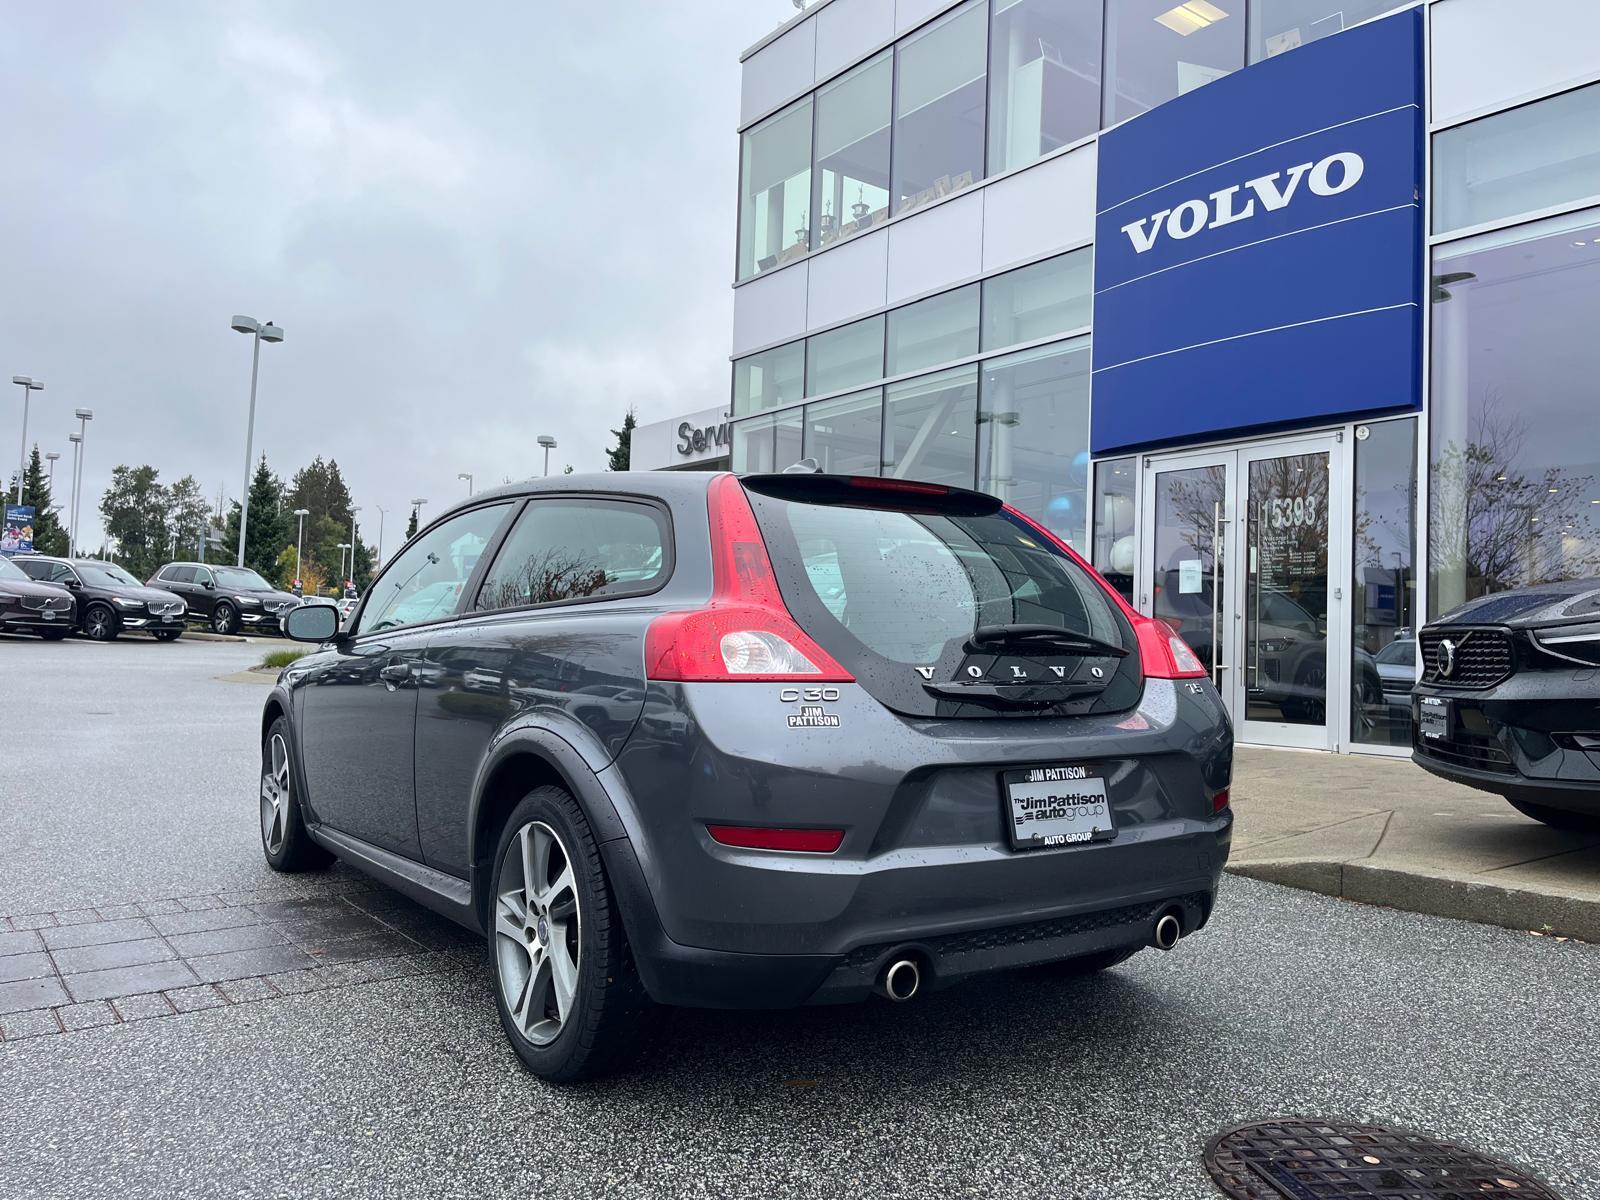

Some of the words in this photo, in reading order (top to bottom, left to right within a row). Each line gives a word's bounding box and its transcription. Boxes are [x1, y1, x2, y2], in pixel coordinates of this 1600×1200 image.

[1121, 152, 1364, 254] VOLVO
[676, 412, 730, 455] Servi
[1262, 496, 1315, 528] 15393
[915, 666, 1104, 680] VOLVO
[1185, 683, 1203, 694] T5
[803, 707, 823, 717] JIM
[789, 716, 839, 726] PATTISON
[1030, 769, 1044, 782] JIM
[1045, 766, 1086, 780] PATTISON
[1044, 835, 1065, 845] AUTO
[1065, 832, 1092, 843] GROUP
